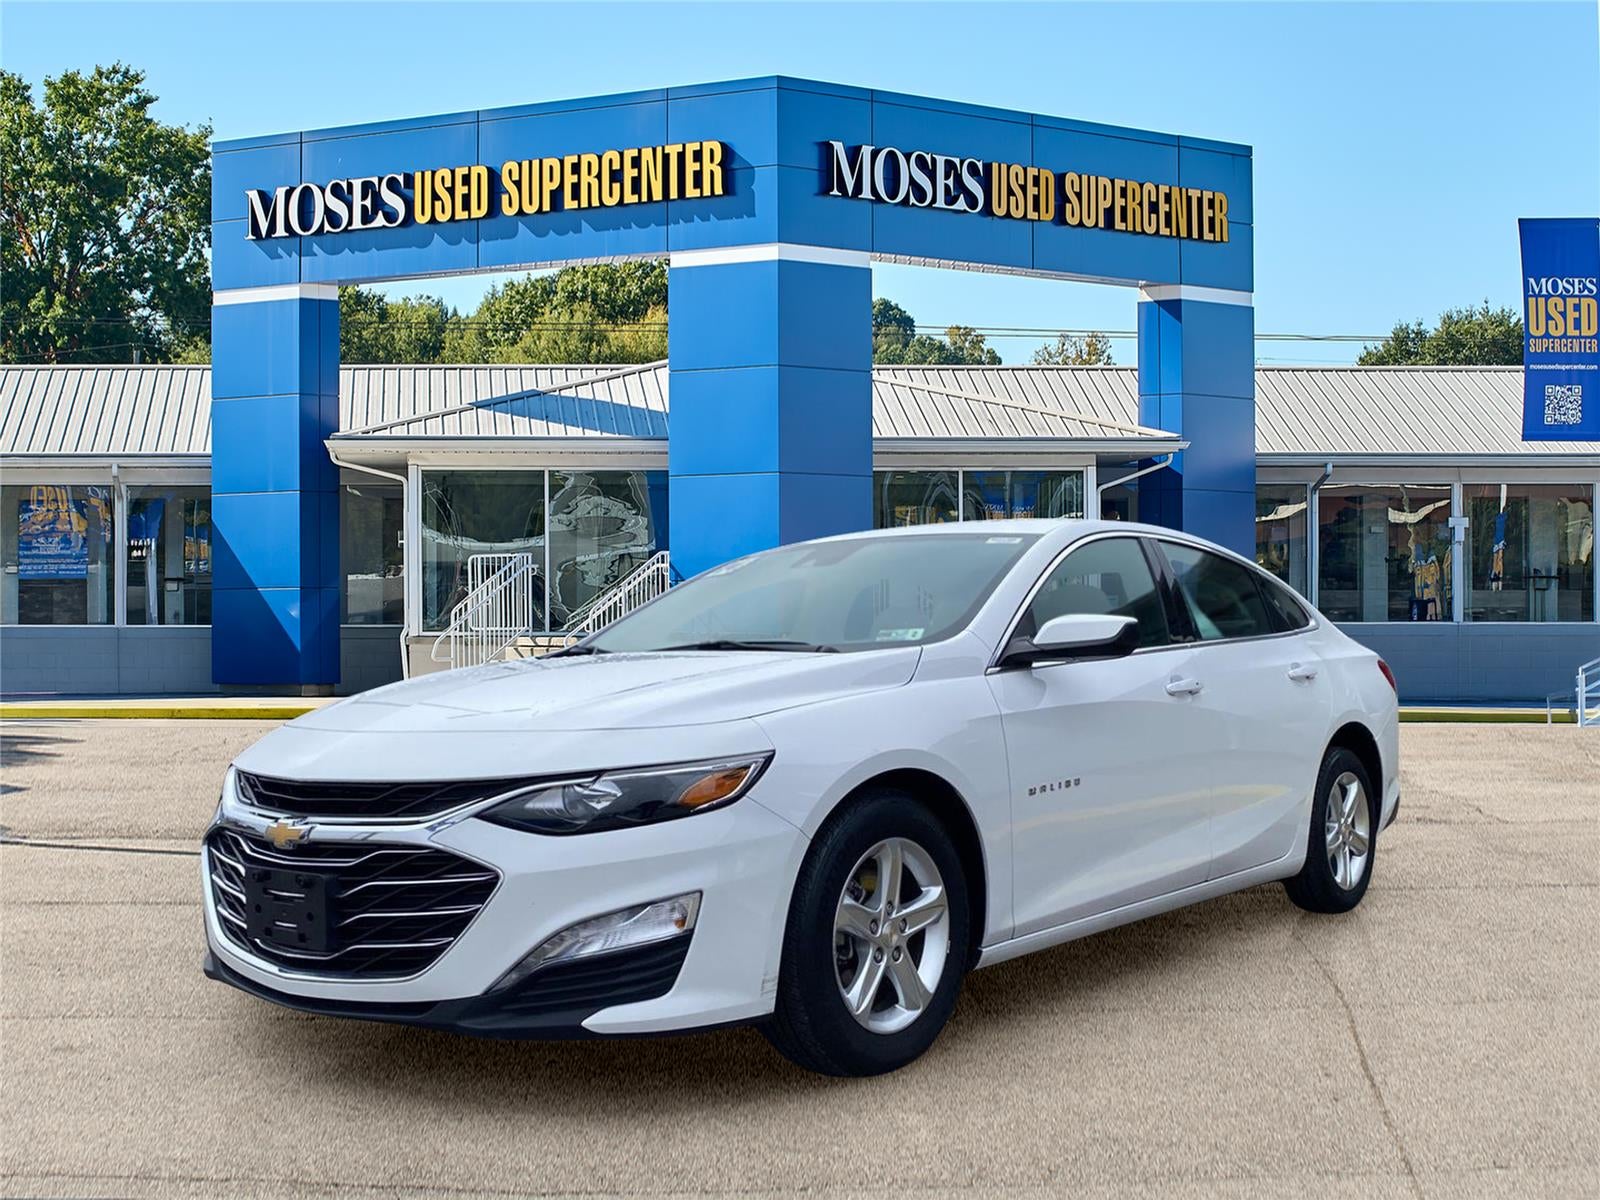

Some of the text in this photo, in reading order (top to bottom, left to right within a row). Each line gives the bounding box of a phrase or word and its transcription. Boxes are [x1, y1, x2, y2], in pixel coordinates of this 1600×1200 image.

[245, 139, 725, 241] MOSES USED SUPERCENTER
[829, 140, 1230, 243] MOSES USED SUPERCENTER
[1527, 277, 1597, 295] MOSES
[1528, 297, 1598, 337] USED
[1529, 338, 1598, 353] SUPERCENTER
